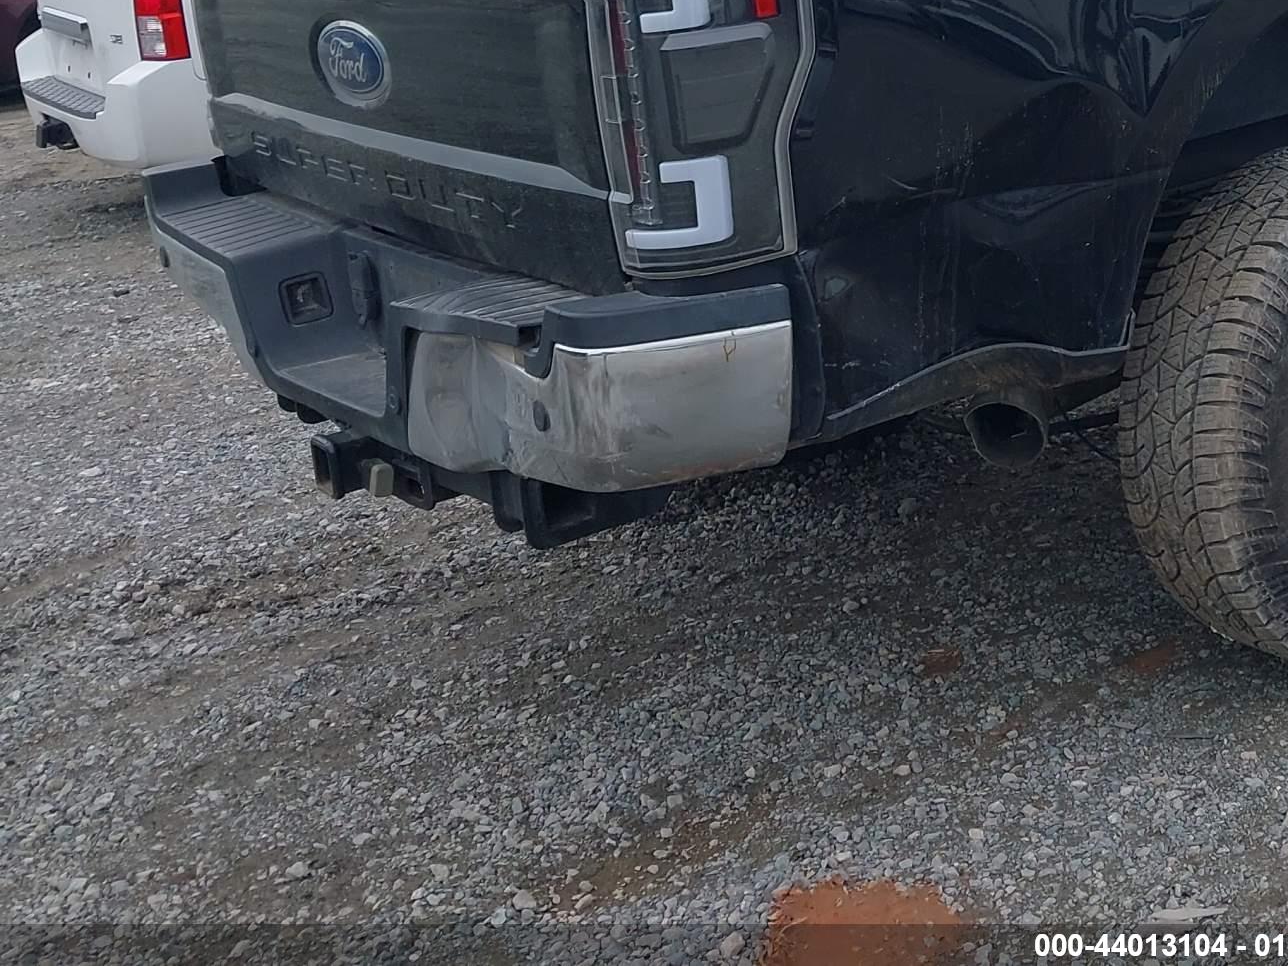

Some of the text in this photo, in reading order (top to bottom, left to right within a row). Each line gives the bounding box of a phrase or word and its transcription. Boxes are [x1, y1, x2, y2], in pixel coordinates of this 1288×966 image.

[328, 37, 367, 82] Ford
[251, 131, 522, 228] SUPER DUTY
